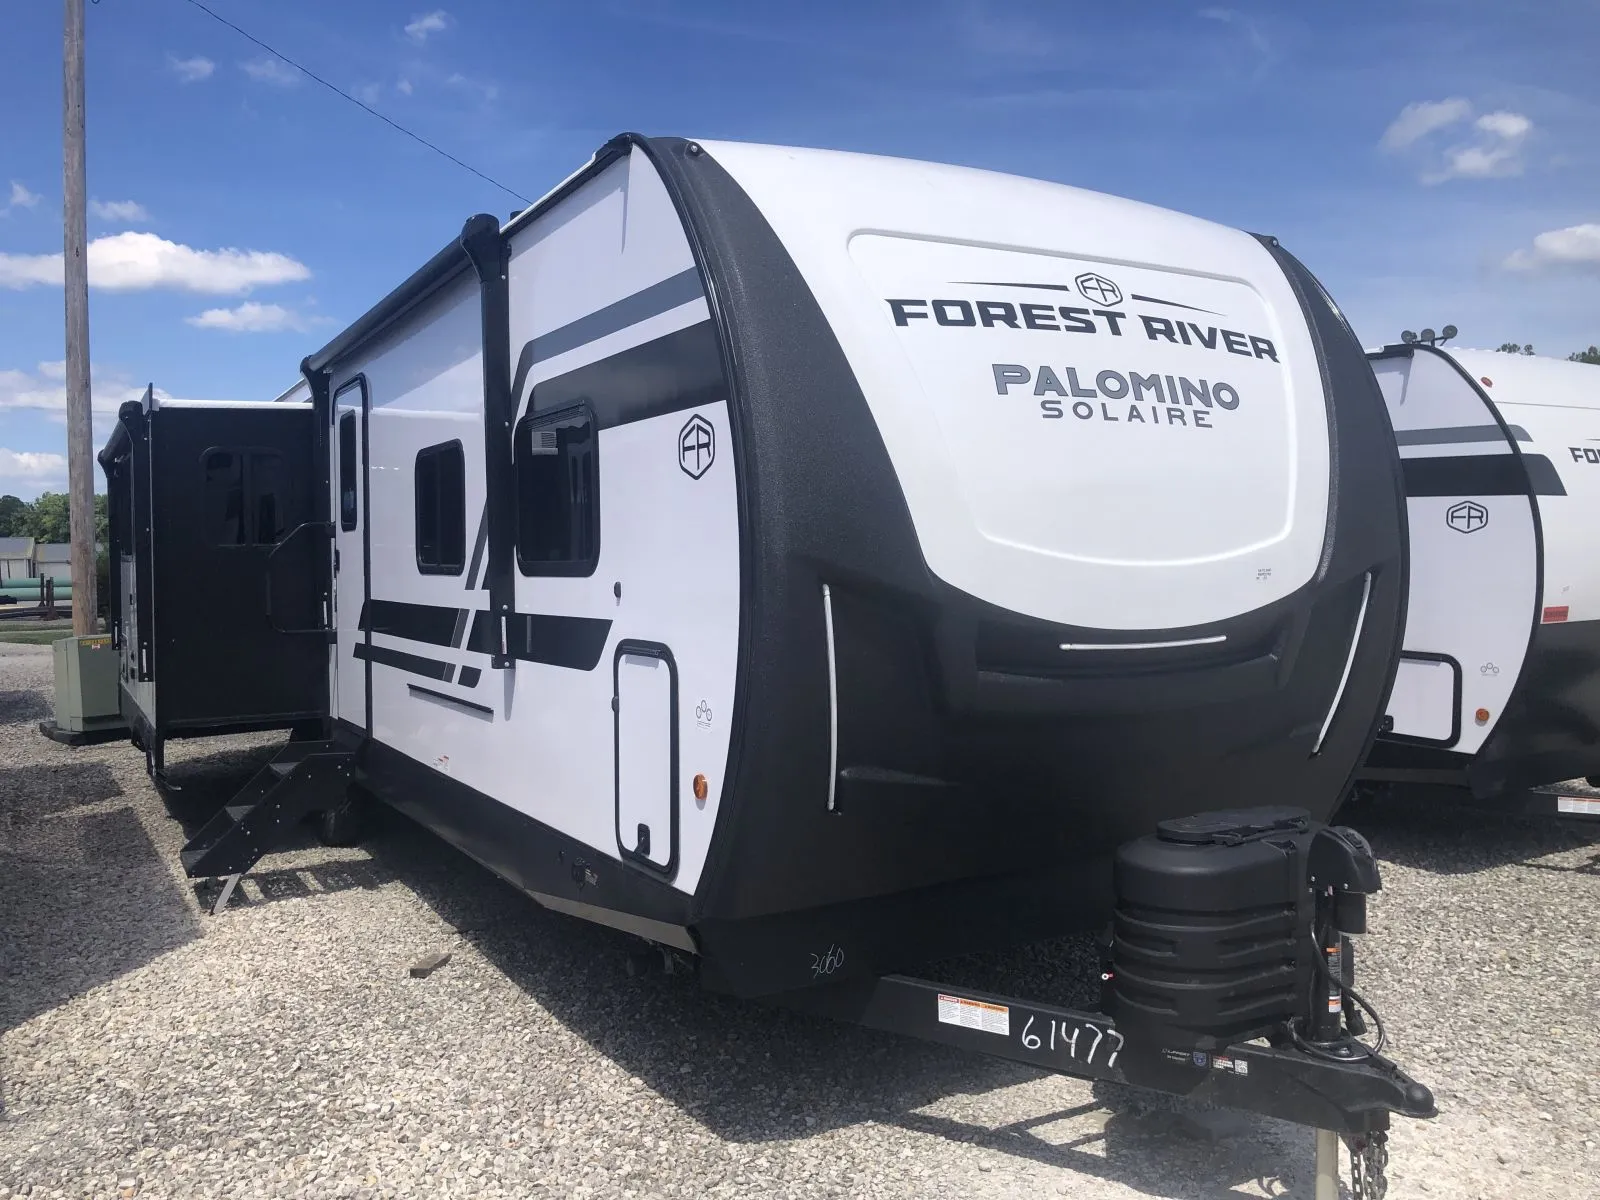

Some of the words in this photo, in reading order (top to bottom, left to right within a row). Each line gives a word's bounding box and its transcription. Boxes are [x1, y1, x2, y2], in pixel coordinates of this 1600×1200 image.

[884, 298, 1127, 336] FOREST
[1138, 314, 1280, 364] RIVER
[992, 363, 1240, 411] PALOMINO
[1041, 399, 1213, 429] SOLAIRE
[1568, 446, 1600, 464] FO
[1021, 1014, 1125, 1068] 61477
